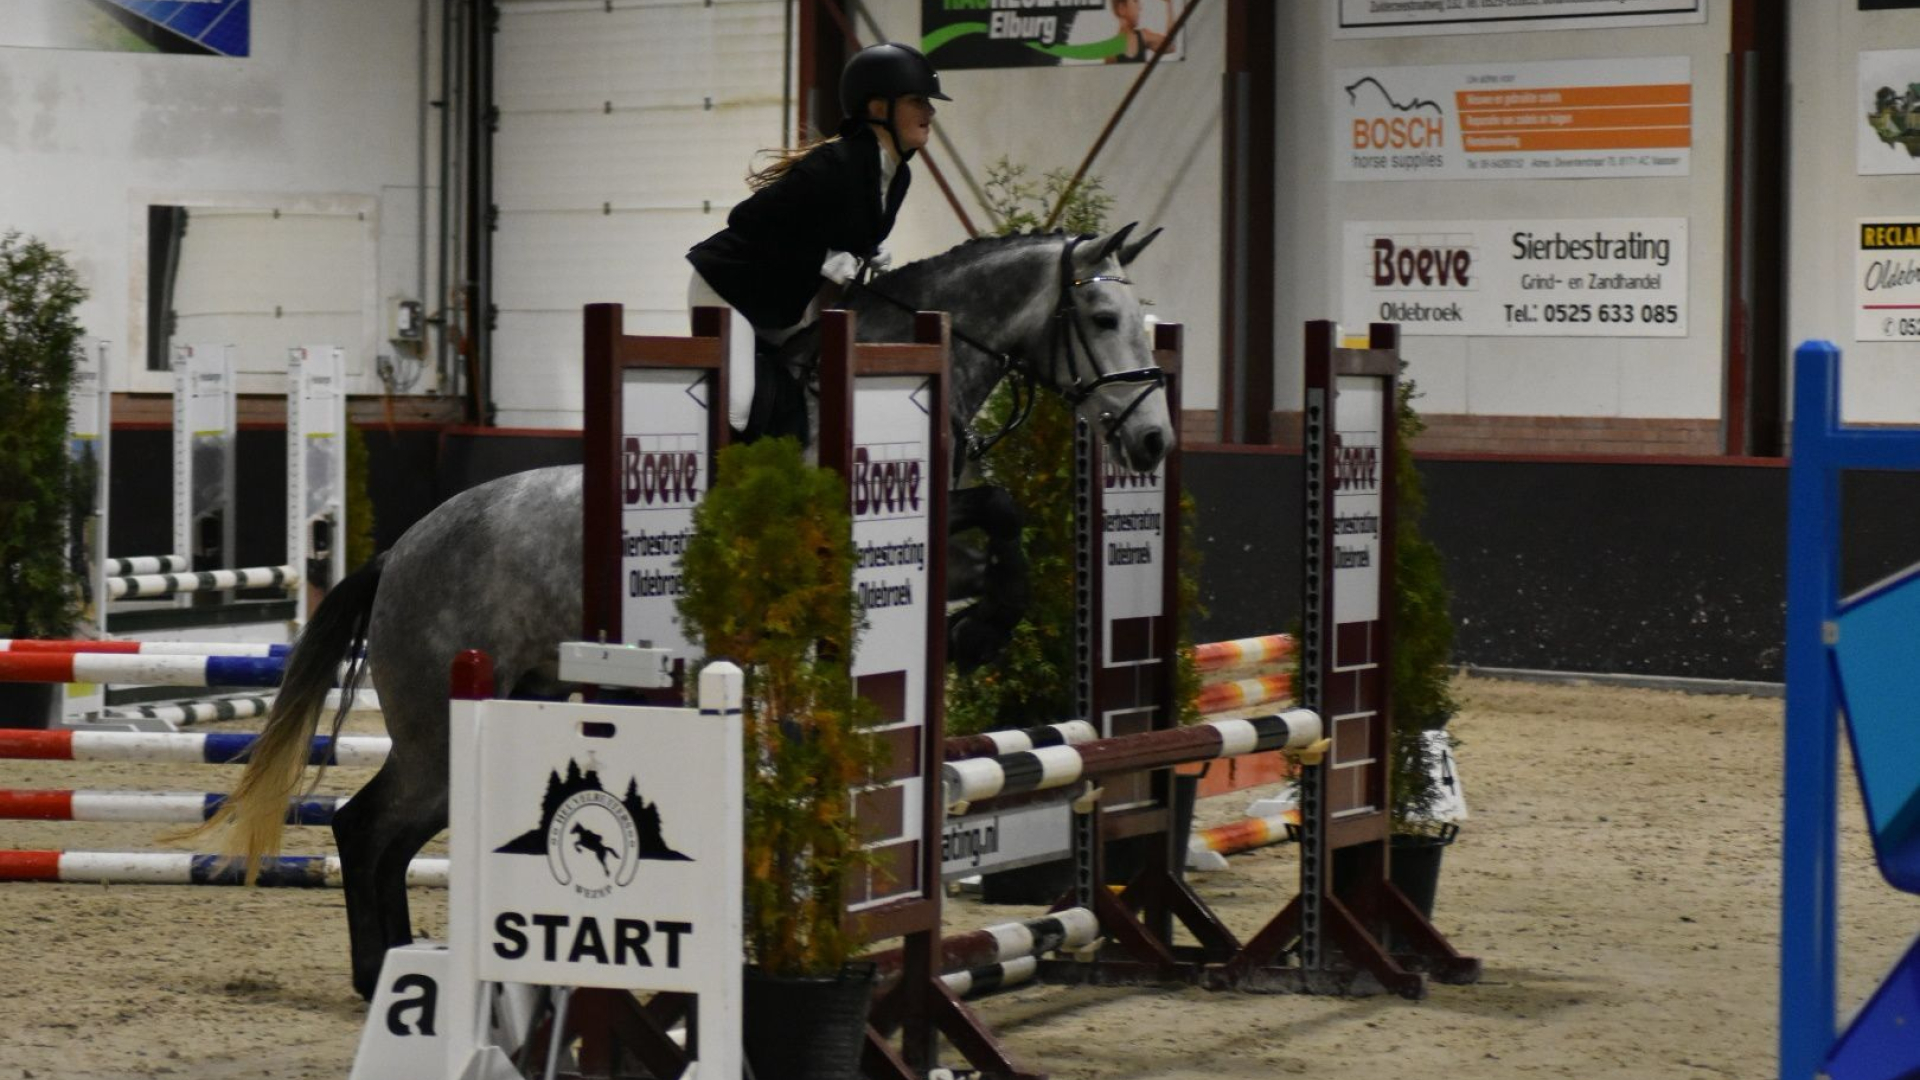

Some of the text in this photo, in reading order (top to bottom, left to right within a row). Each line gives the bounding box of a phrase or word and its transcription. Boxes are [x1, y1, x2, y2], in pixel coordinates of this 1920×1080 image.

[990, 11, 1057, 44] Elburg
[1353, 117, 1443, 149] BOSCH
[1353, 151, 1443, 170] horse supplies
[1373, 238, 1471, 287] Boeve
[1512, 232, 1670, 266] Sierbestrating
[1521, 273, 1661, 290] Grind- en Zandhandel
[1380, 302, 1462, 322] Oldebroek
[1544, 304, 1592, 323] 0525
[1598, 304, 1634, 323] 633
[1640, 304, 1678, 323] 085
[625, 437, 698, 505] Boeve
[854, 447, 921, 516] Boeve
[629, 569, 686, 598] Oldebroe
[493, 911, 693, 969] START
[386, 973, 438, 1037] a
